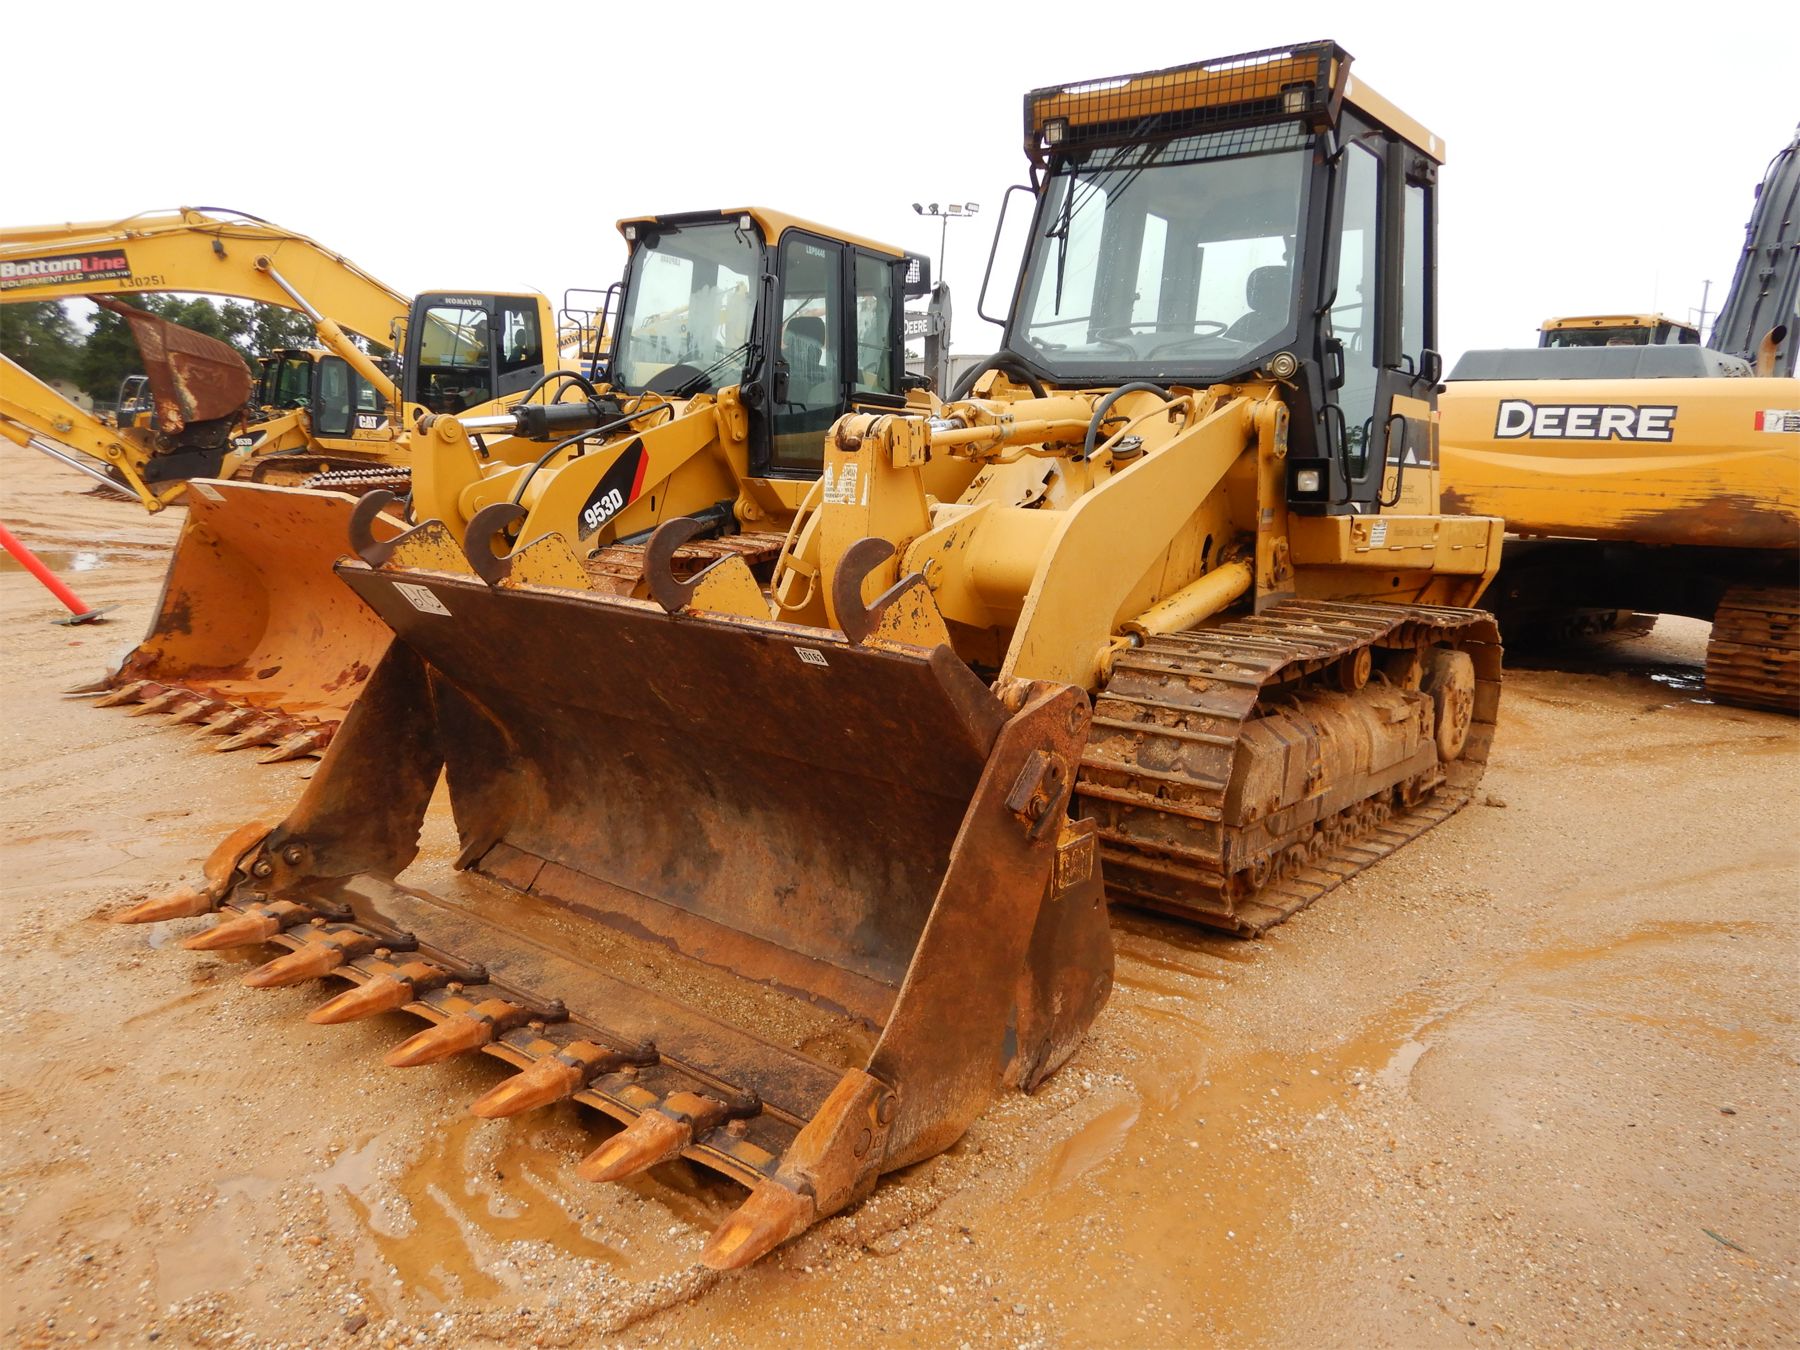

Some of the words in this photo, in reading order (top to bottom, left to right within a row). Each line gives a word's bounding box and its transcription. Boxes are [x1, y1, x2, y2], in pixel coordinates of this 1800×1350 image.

[1, 276, 63, 288] EQUIPMENT
[65, 273, 84, 281] LLC
[444, 297, 483, 306] KOMATSU
[358, 415, 378, 429] CAT
[1496, 401, 1675, 440] DEERE
[584, 488, 624, 529] 953D
